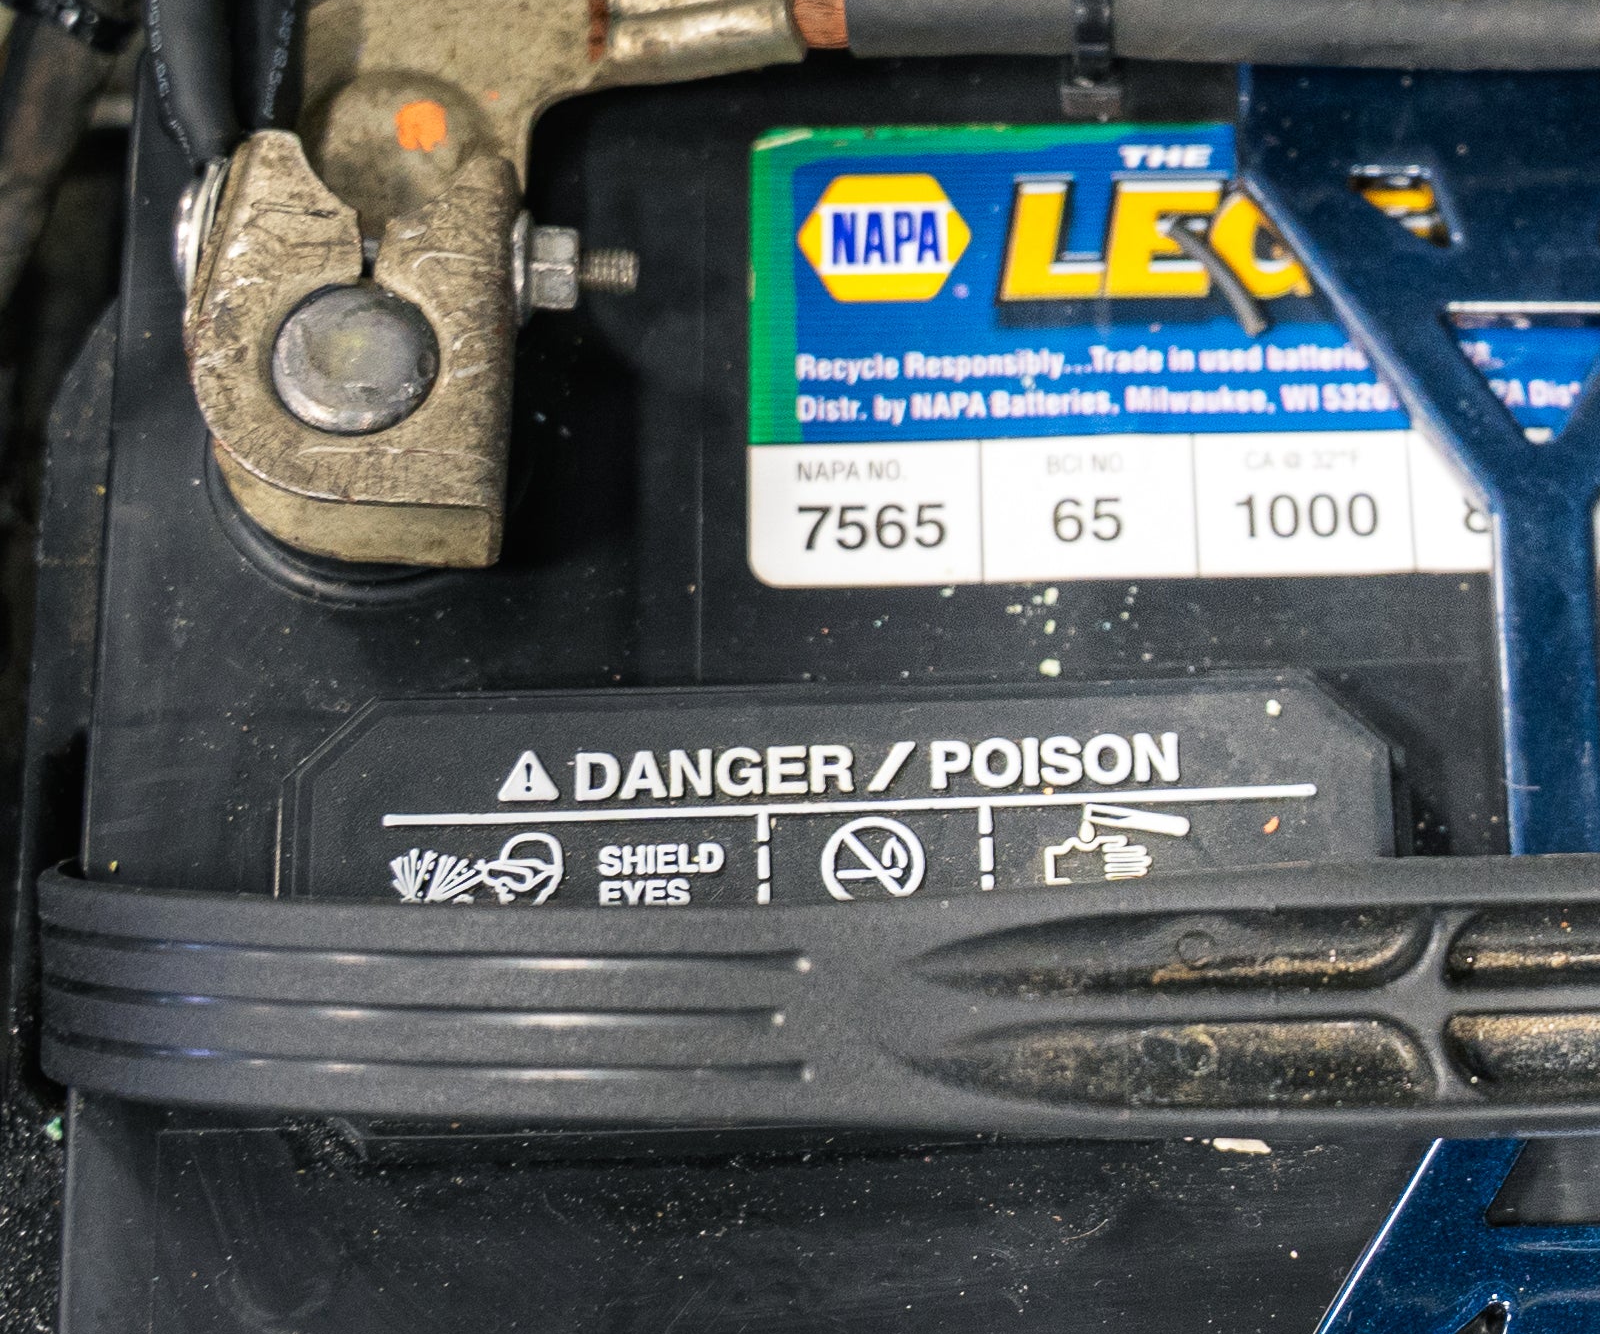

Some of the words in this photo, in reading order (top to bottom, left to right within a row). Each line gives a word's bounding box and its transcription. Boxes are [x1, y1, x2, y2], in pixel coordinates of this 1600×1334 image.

[1118, 145, 1214, 168] THE
[829, 210, 941, 265] NAPA
[796, 352, 900, 385] Recycle
[1168, 345, 1196, 373] in
[1199, 345, 1264, 373] used
[796, 395, 868, 422] Distr.
[873, 394, 906, 426] by
[910, 390, 987, 419] NAPA
[1280, 384, 1320, 413] WI
[796, 460, 861, 482] NAPA
[797, 502, 947, 552] 7565
[1052, 497, 1124, 543] 65
[1235, 492, 1380, 541] 1000
[575, 746, 855, 801] DANGER
[931, 731, 1180, 791] POISON
[599, 842, 725, 877] SHIELD
[599, 879, 692, 906] EYES
